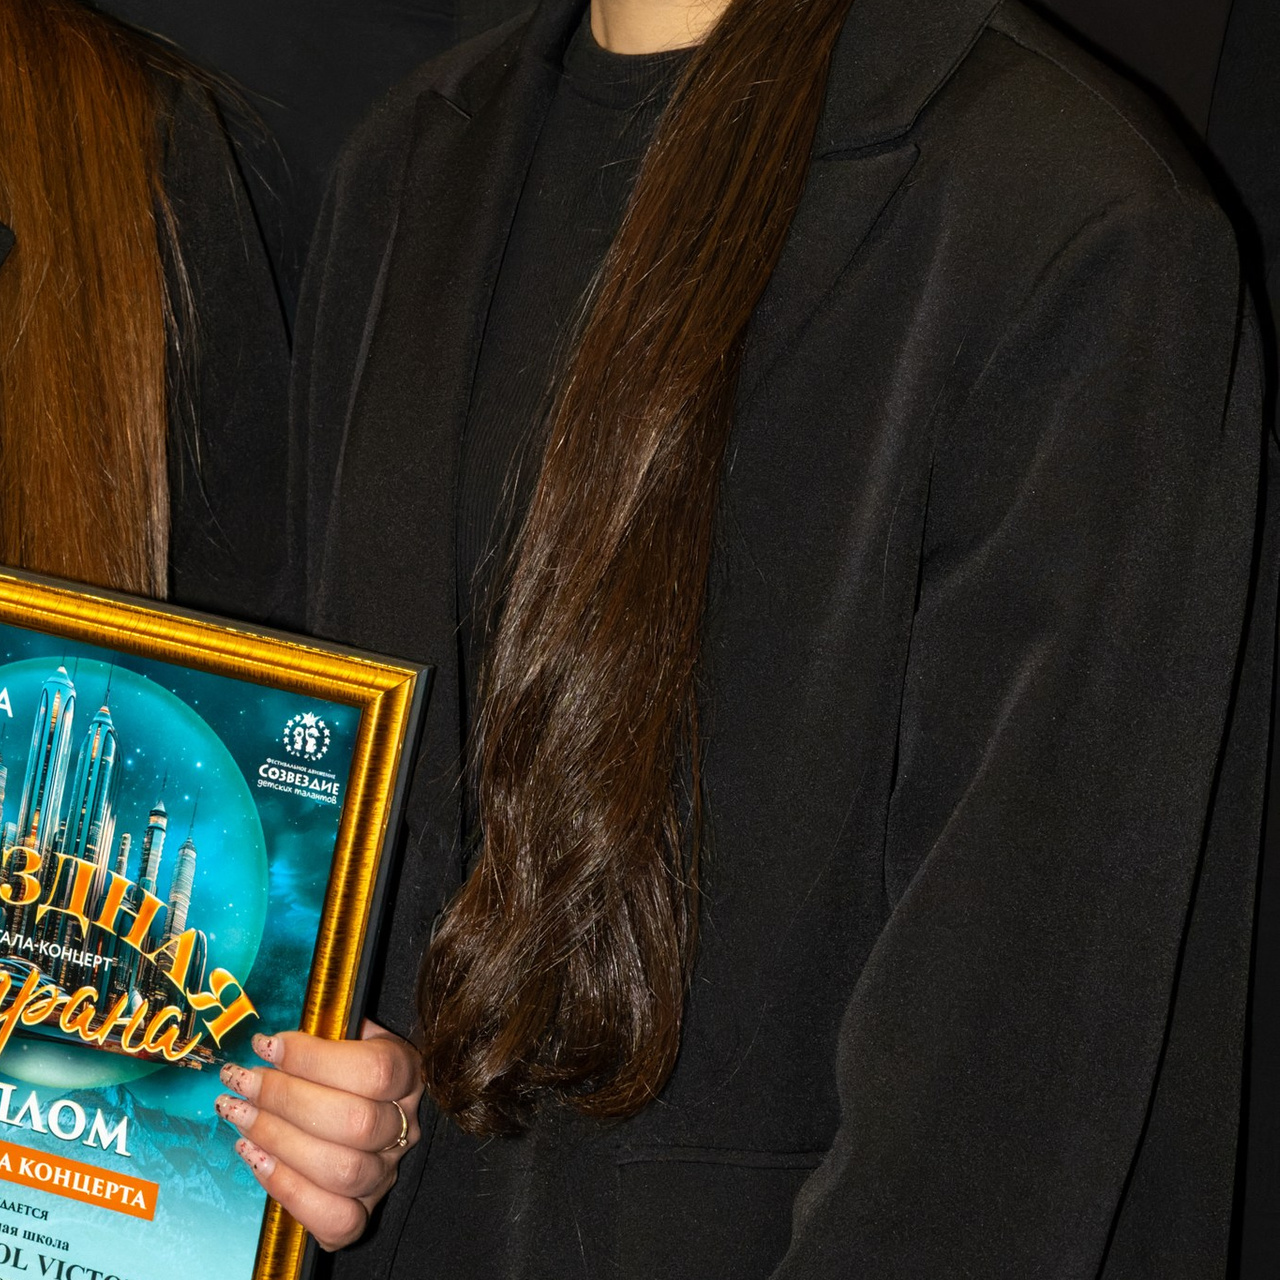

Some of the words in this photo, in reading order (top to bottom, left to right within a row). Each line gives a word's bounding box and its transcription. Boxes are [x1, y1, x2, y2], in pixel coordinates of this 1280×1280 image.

[257, 778, 292, 793] детских
[294, 788, 337, 805] талантов
[258, 764, 340, 795] СОЗВЕЗДИЕ
[17, 1156, 148, 1210] КОНЦЕРТА
[22, 1229, 71, 1252] школа
